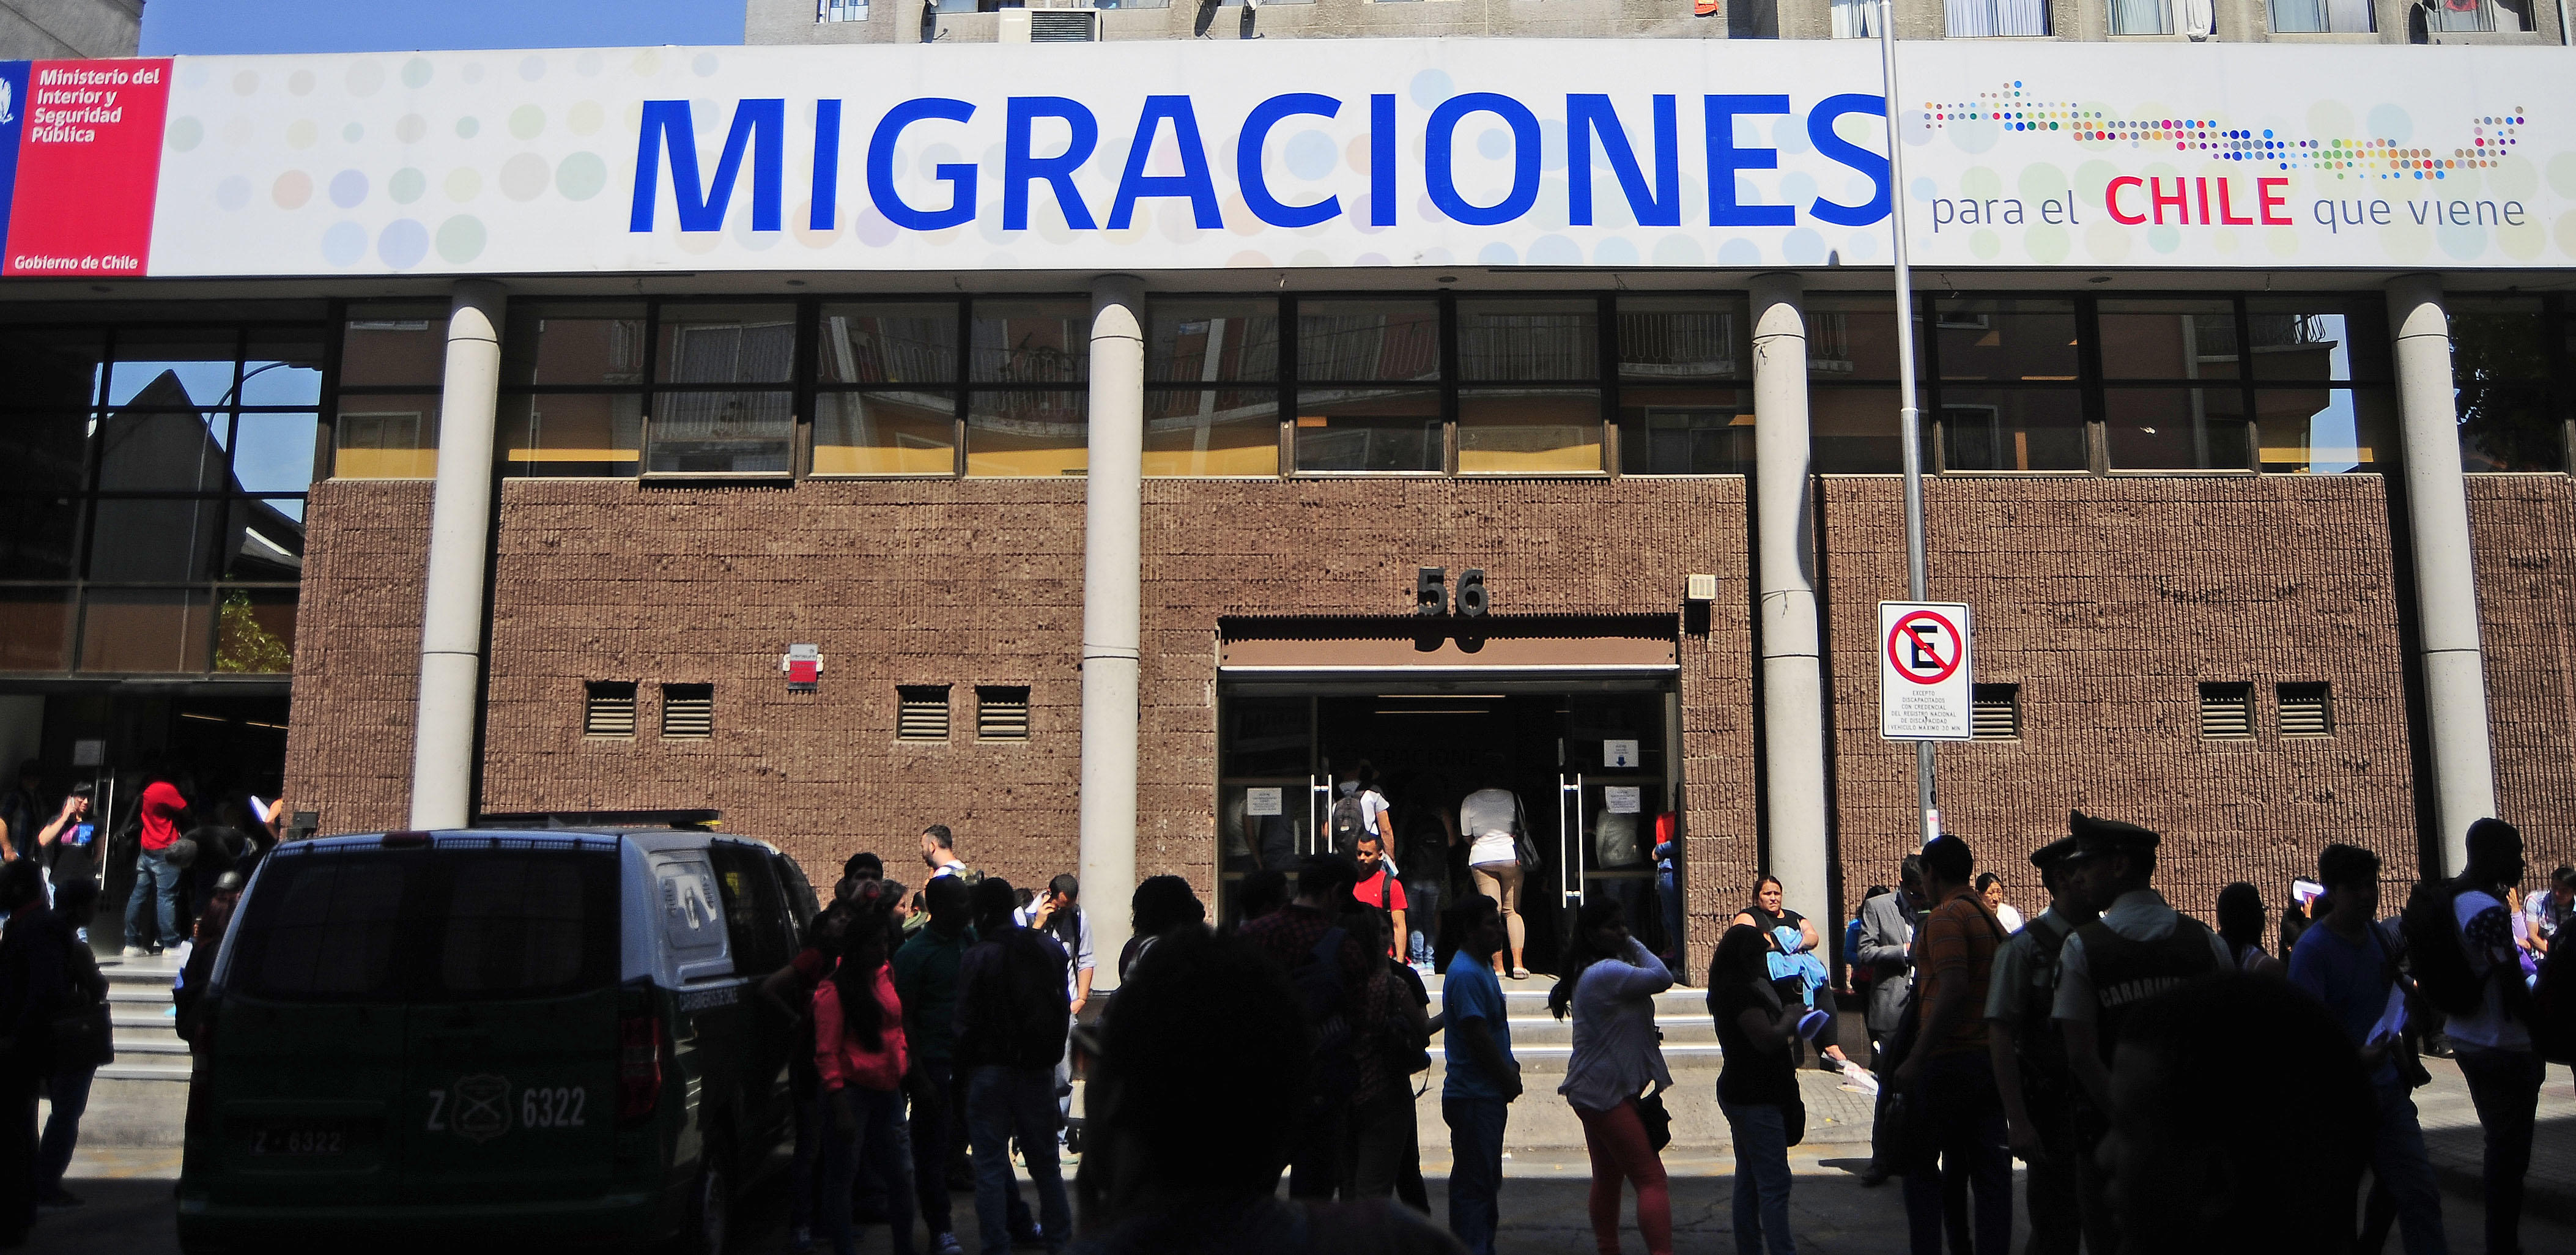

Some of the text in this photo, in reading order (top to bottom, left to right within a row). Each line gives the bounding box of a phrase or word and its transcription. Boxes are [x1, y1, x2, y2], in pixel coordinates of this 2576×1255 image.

[39, 68, 160, 86] Ministerio del
[37, 88, 117, 107] Interior y
[34, 106, 122, 127] Seguridad
[31, 125, 95, 143] Pública
[629, 92, 1893, 232] MIGRACIONES
[1933, 176, 2525, 234] para el CHILE que viene
[15, 254, 138, 270] Gobierno de Chile
[1418, 566, 1489, 616] 56
[1911, 625, 1941, 668] E
[427, 1086, 585, 1131] Z 6322
